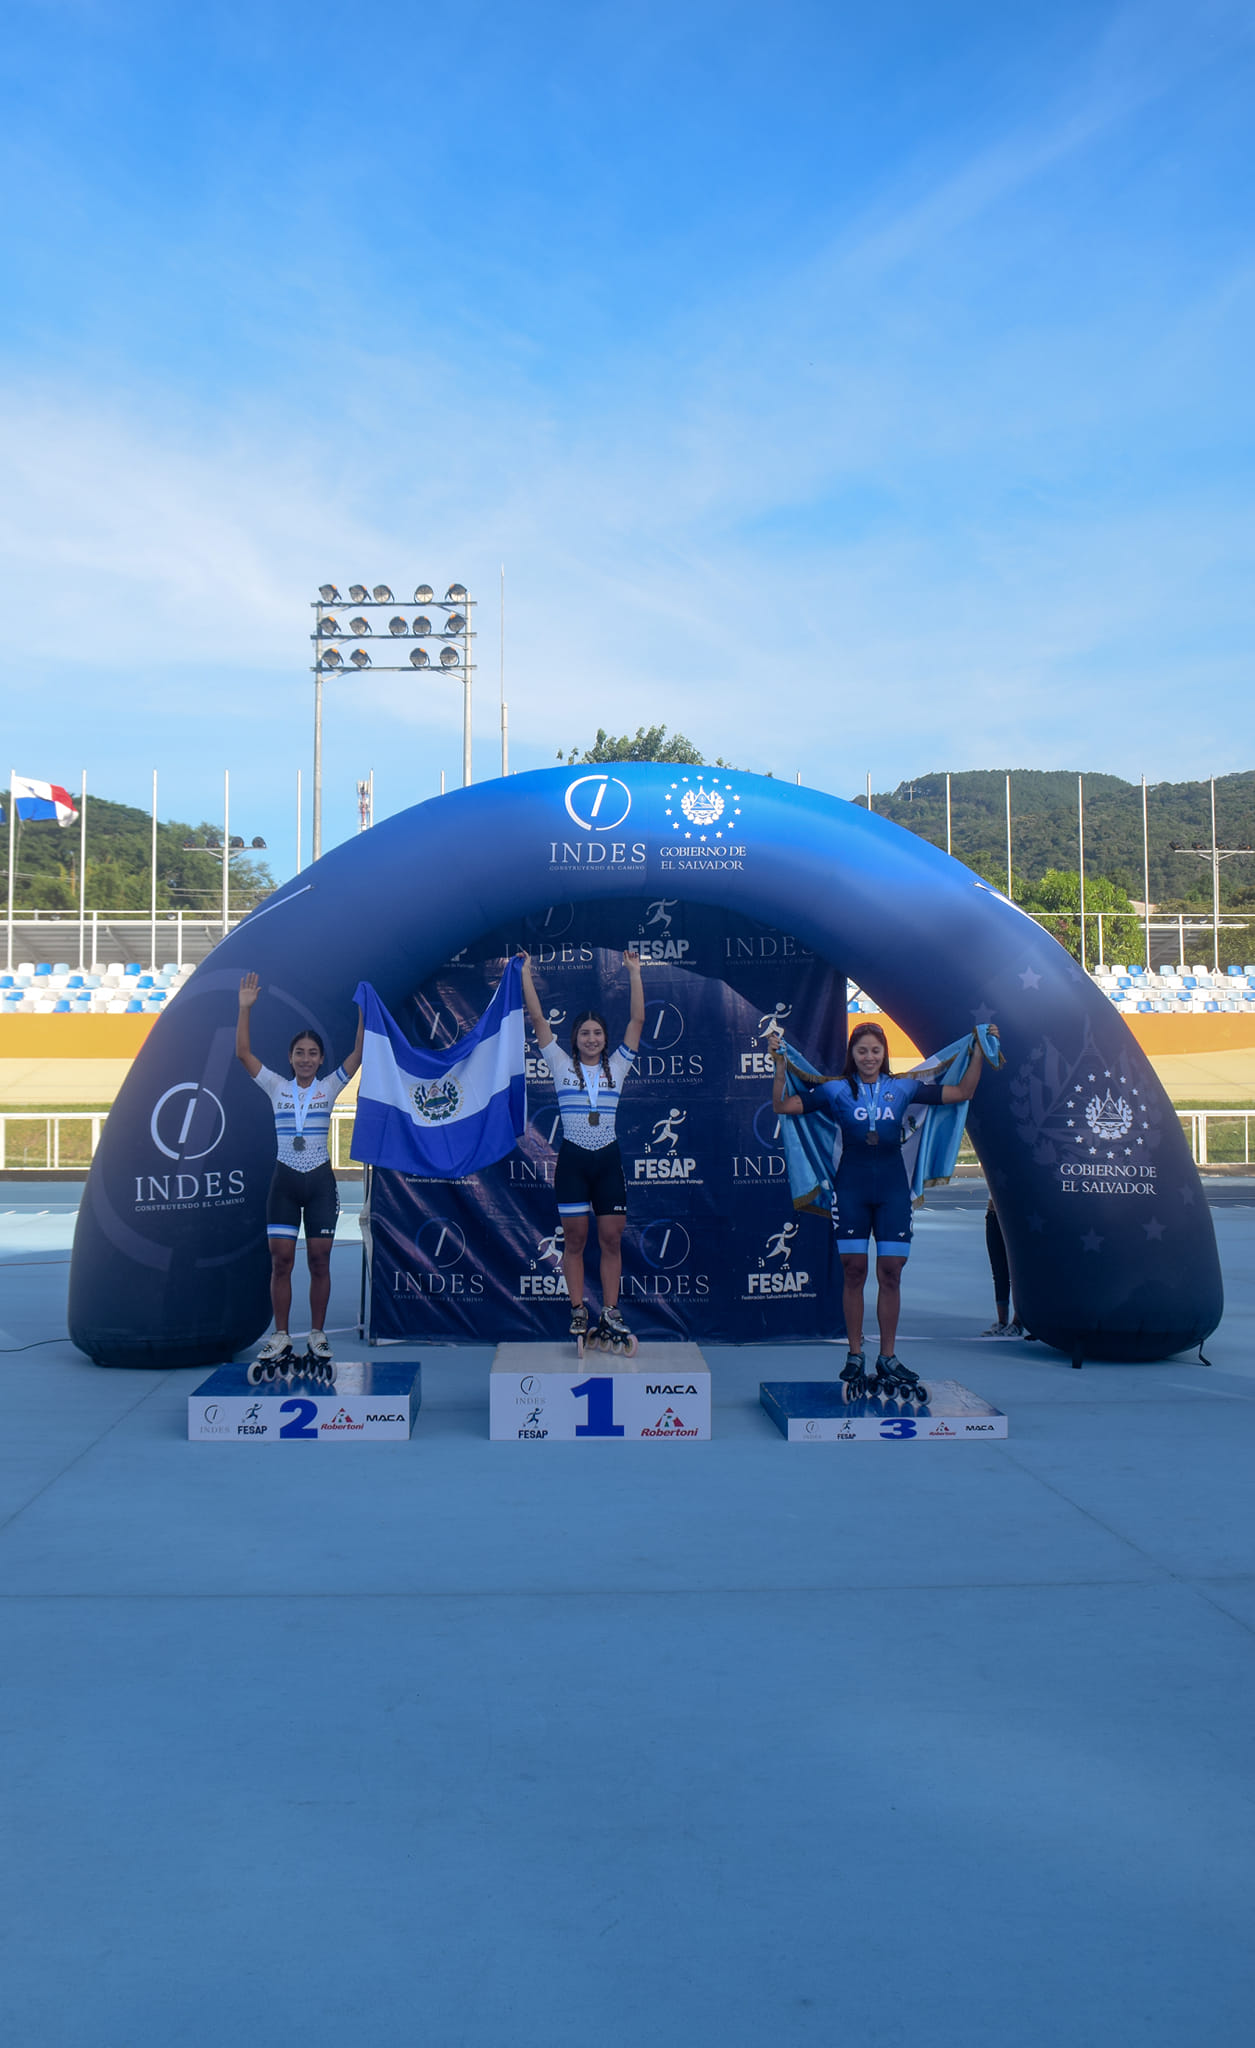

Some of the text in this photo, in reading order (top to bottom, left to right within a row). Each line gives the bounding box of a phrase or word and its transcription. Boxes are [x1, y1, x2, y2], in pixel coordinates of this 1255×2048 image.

[549, 842, 646, 864] INDES
[660, 846, 746, 858] GOBIERNO DE
[661, 860, 744, 871] EL SALVADOR
[628, 939, 689, 960] FESAP
[629, 1055, 705, 1077] NDES
[740, 1053, 775, 1073] FES
[634, 1158, 697, 1179] FESAP
[733, 1155, 786, 1177] IND
[1060, 1163, 1157, 1178] GOBIERNO DE
[135, 1169, 246, 1203] INDES
[1062, 1181, 1157, 1195] EL SALVADOR
[135, 1202, 200, 1212] CONSTRUYENDO
[215, 1196, 245, 1208] CAMINO
[393, 1271, 485, 1295] INDES
[520, 1275, 570, 1296] FESA
[621, 1274, 711, 1296] INDES
[748, 1271, 809, 1294] FESAP
[646, 1384, 698, 1395] MACA
[515, 1397, 546, 1405] INDES
[570, 1377, 625, 1437] 1
[280, 1398, 318, 1439] 2
[321, 1423, 364, 1431] Robertoni
[366, 1414, 405, 1422] MACA
[200, 1425, 230, 1434] INDES
[237, 1425, 268, 1435] FESAP
[518, 1429, 548, 1439] FESAP
[641, 1427, 699, 1437] Robertoni
[879, 1418, 918, 1439] 3
[965, 1424, 995, 1432] MACA
